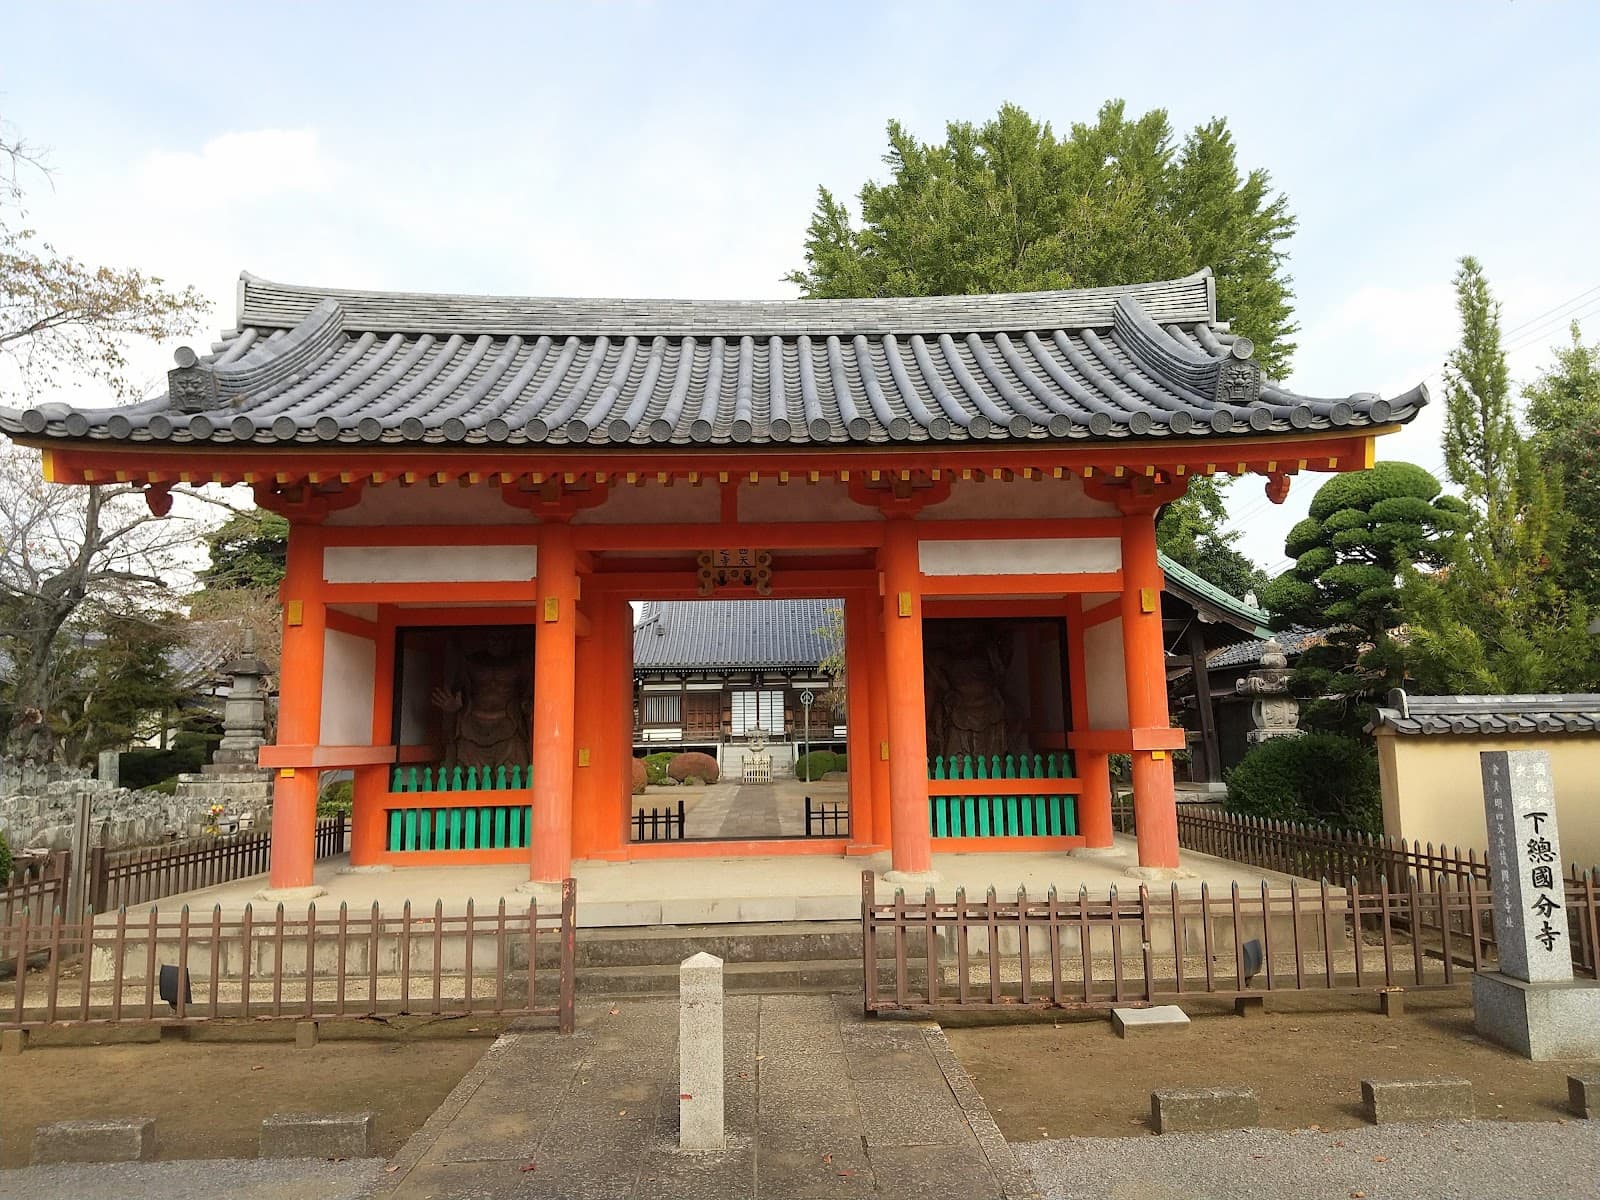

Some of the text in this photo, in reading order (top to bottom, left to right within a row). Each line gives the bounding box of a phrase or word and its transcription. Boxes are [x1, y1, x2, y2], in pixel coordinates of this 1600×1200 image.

[1522, 811, 1561, 953] 下總國分寺
